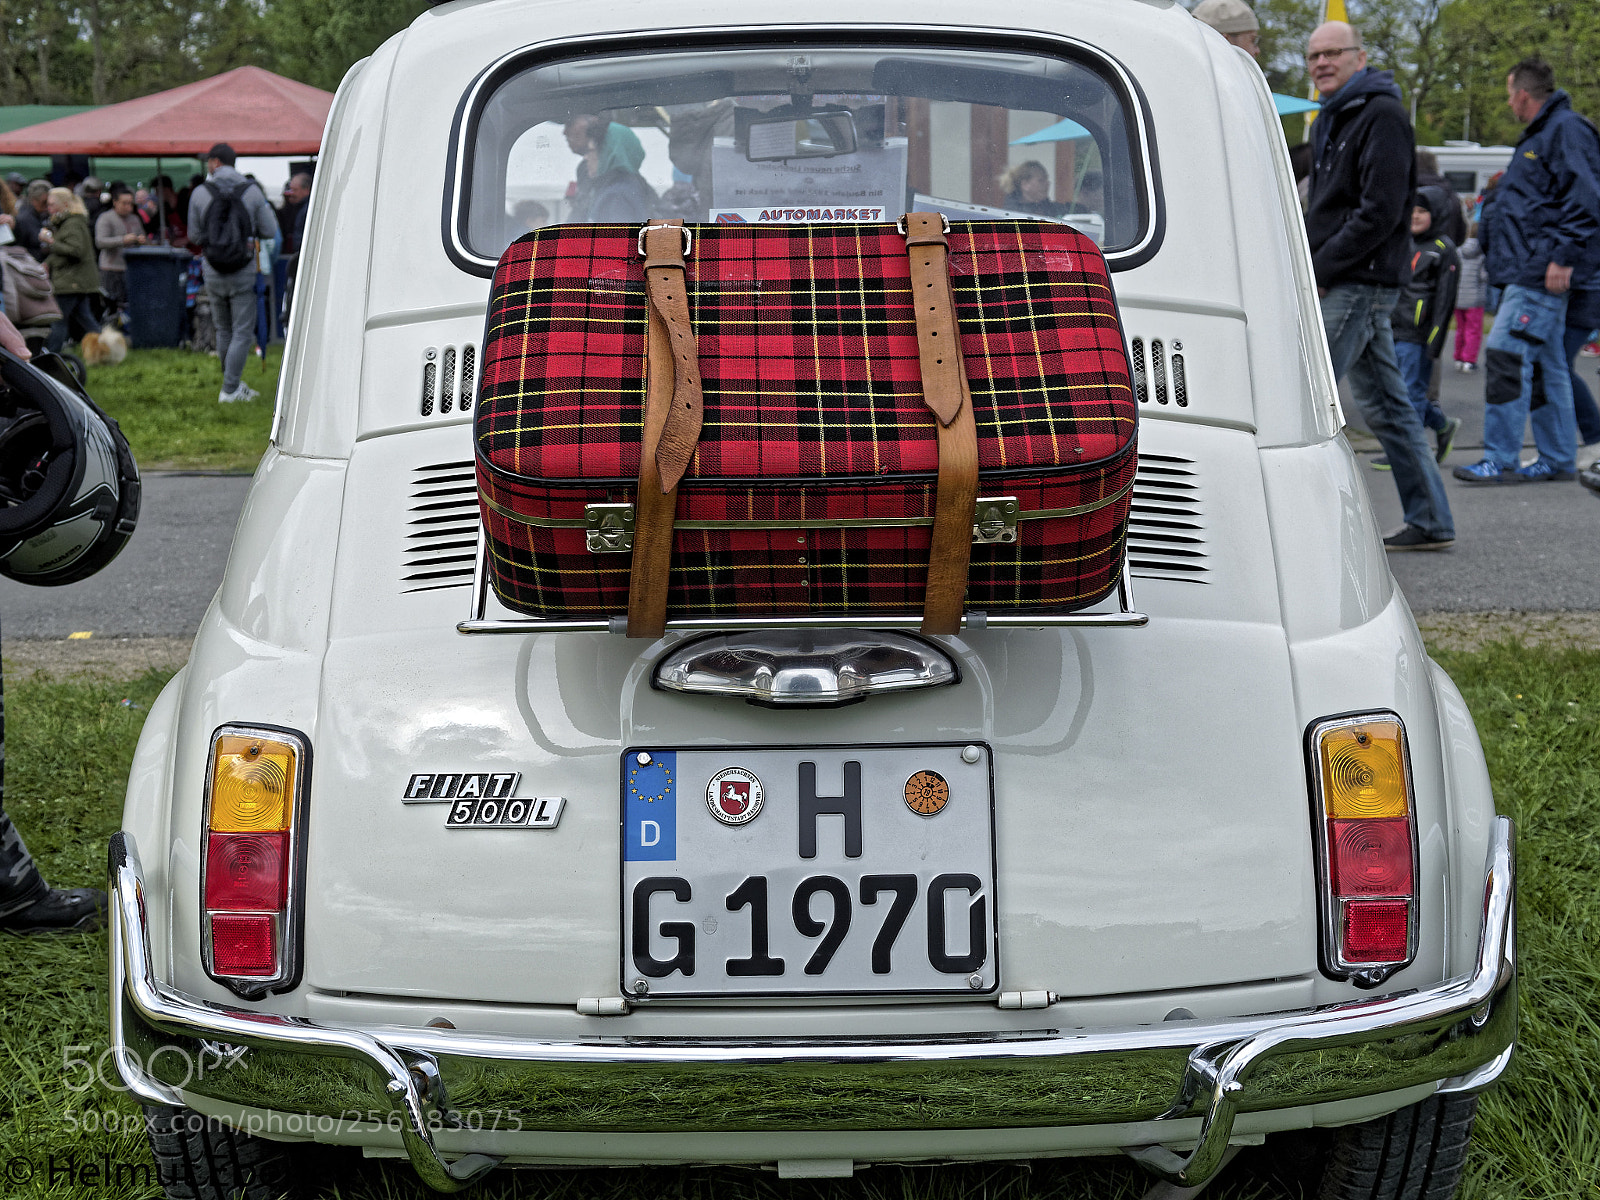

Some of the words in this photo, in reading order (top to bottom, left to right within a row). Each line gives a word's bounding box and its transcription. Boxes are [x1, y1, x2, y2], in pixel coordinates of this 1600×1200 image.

[758, 208, 882, 221] AUTOMARKET
[409, 775, 513, 798] FIAT
[453, 800, 552, 823] 500L
[798, 761, 862, 858] H
[640, 820, 661, 847] D
[632, 876, 696, 976] G
[725, 873, 987, 976] 1970
